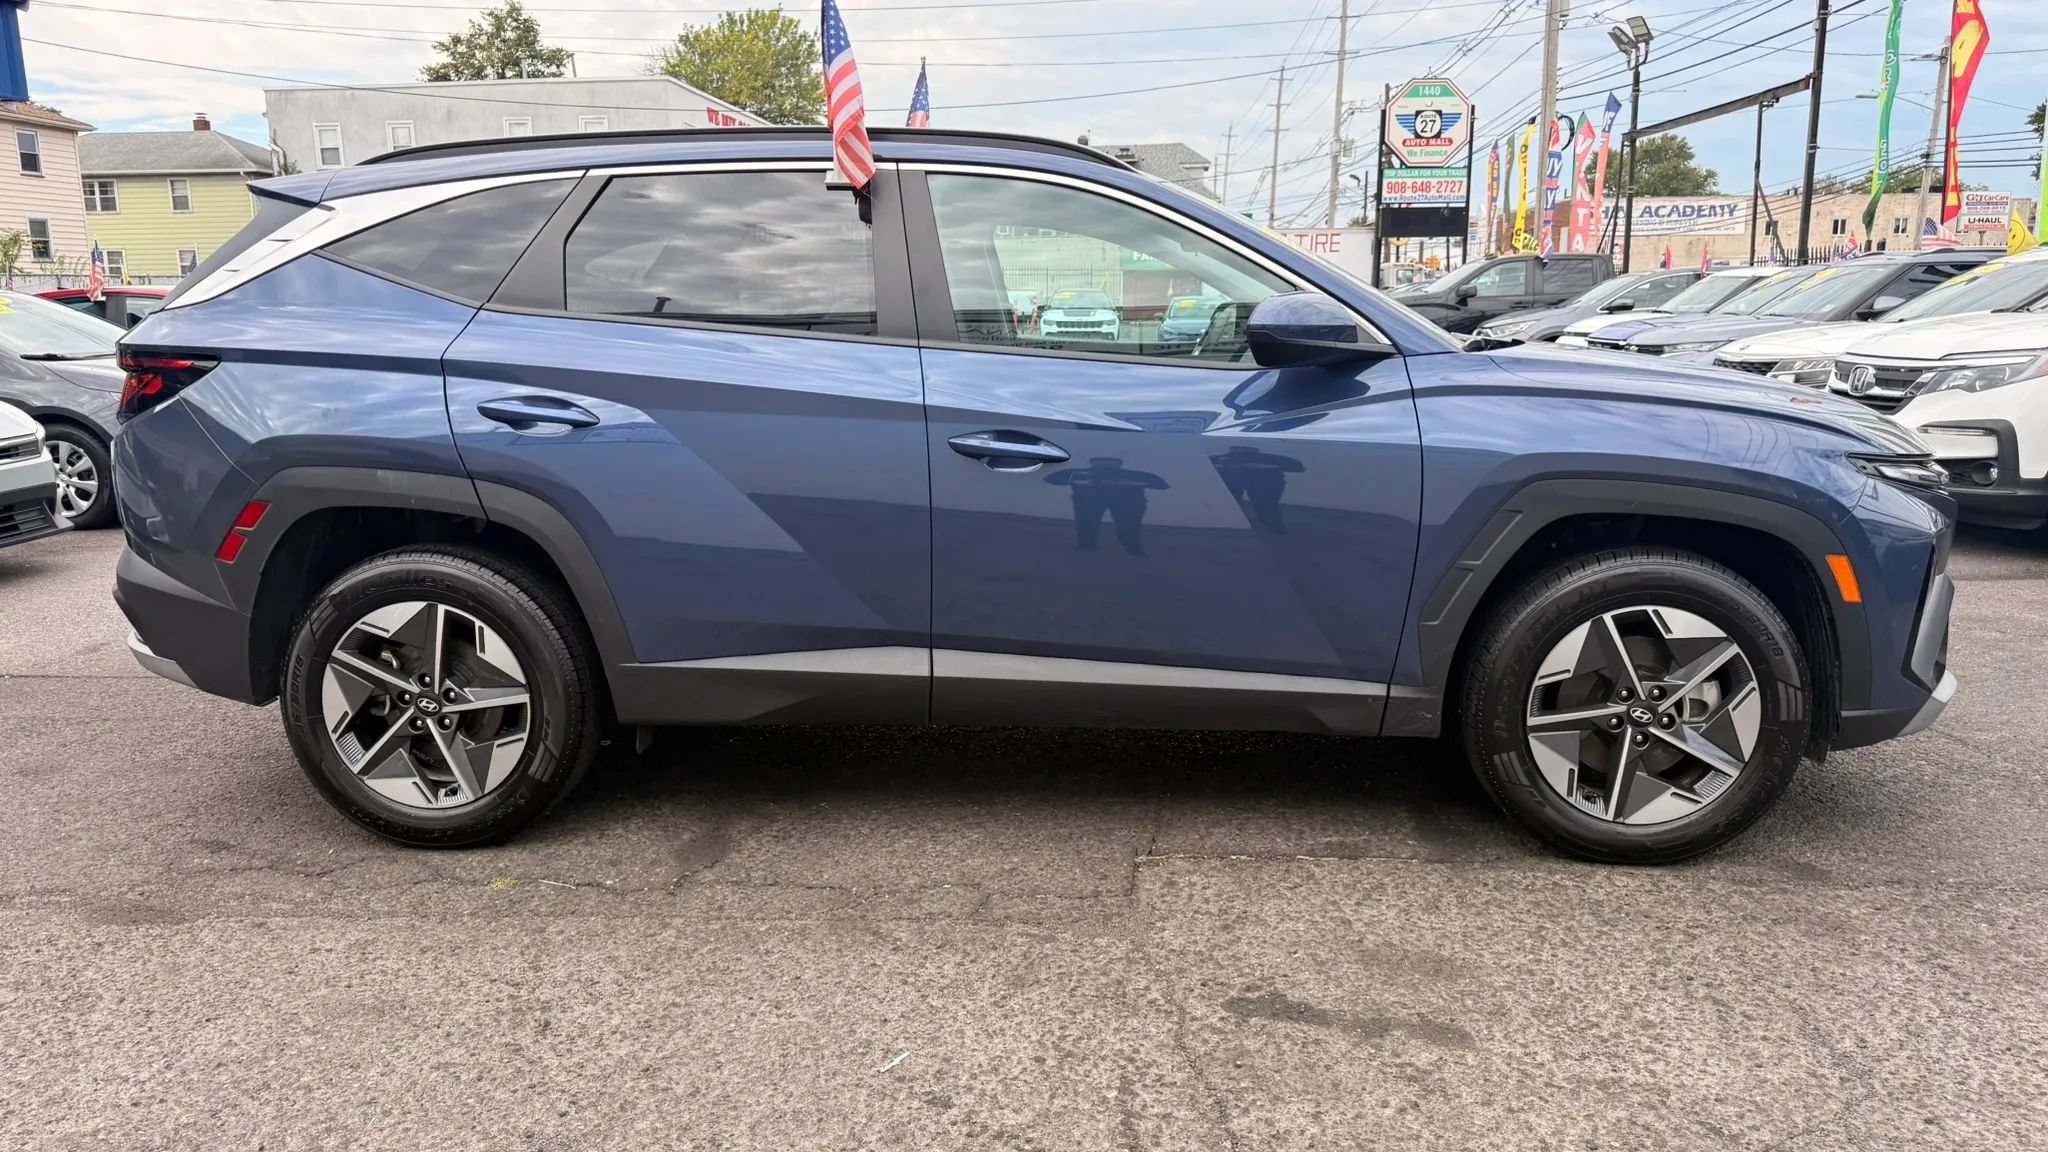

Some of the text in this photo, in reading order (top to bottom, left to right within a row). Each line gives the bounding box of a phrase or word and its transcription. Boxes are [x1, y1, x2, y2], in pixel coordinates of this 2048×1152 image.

[1418, 85, 1441, 96] 1440
[1420, 119, 1437, 133] 27
[1406, 148, 1448, 157] We Finance
[1386, 180, 1463, 194] 908-648-2727
[1639, 204, 1738, 218] ACADEMY
[1294, 233, 1342, 253] TIRE
